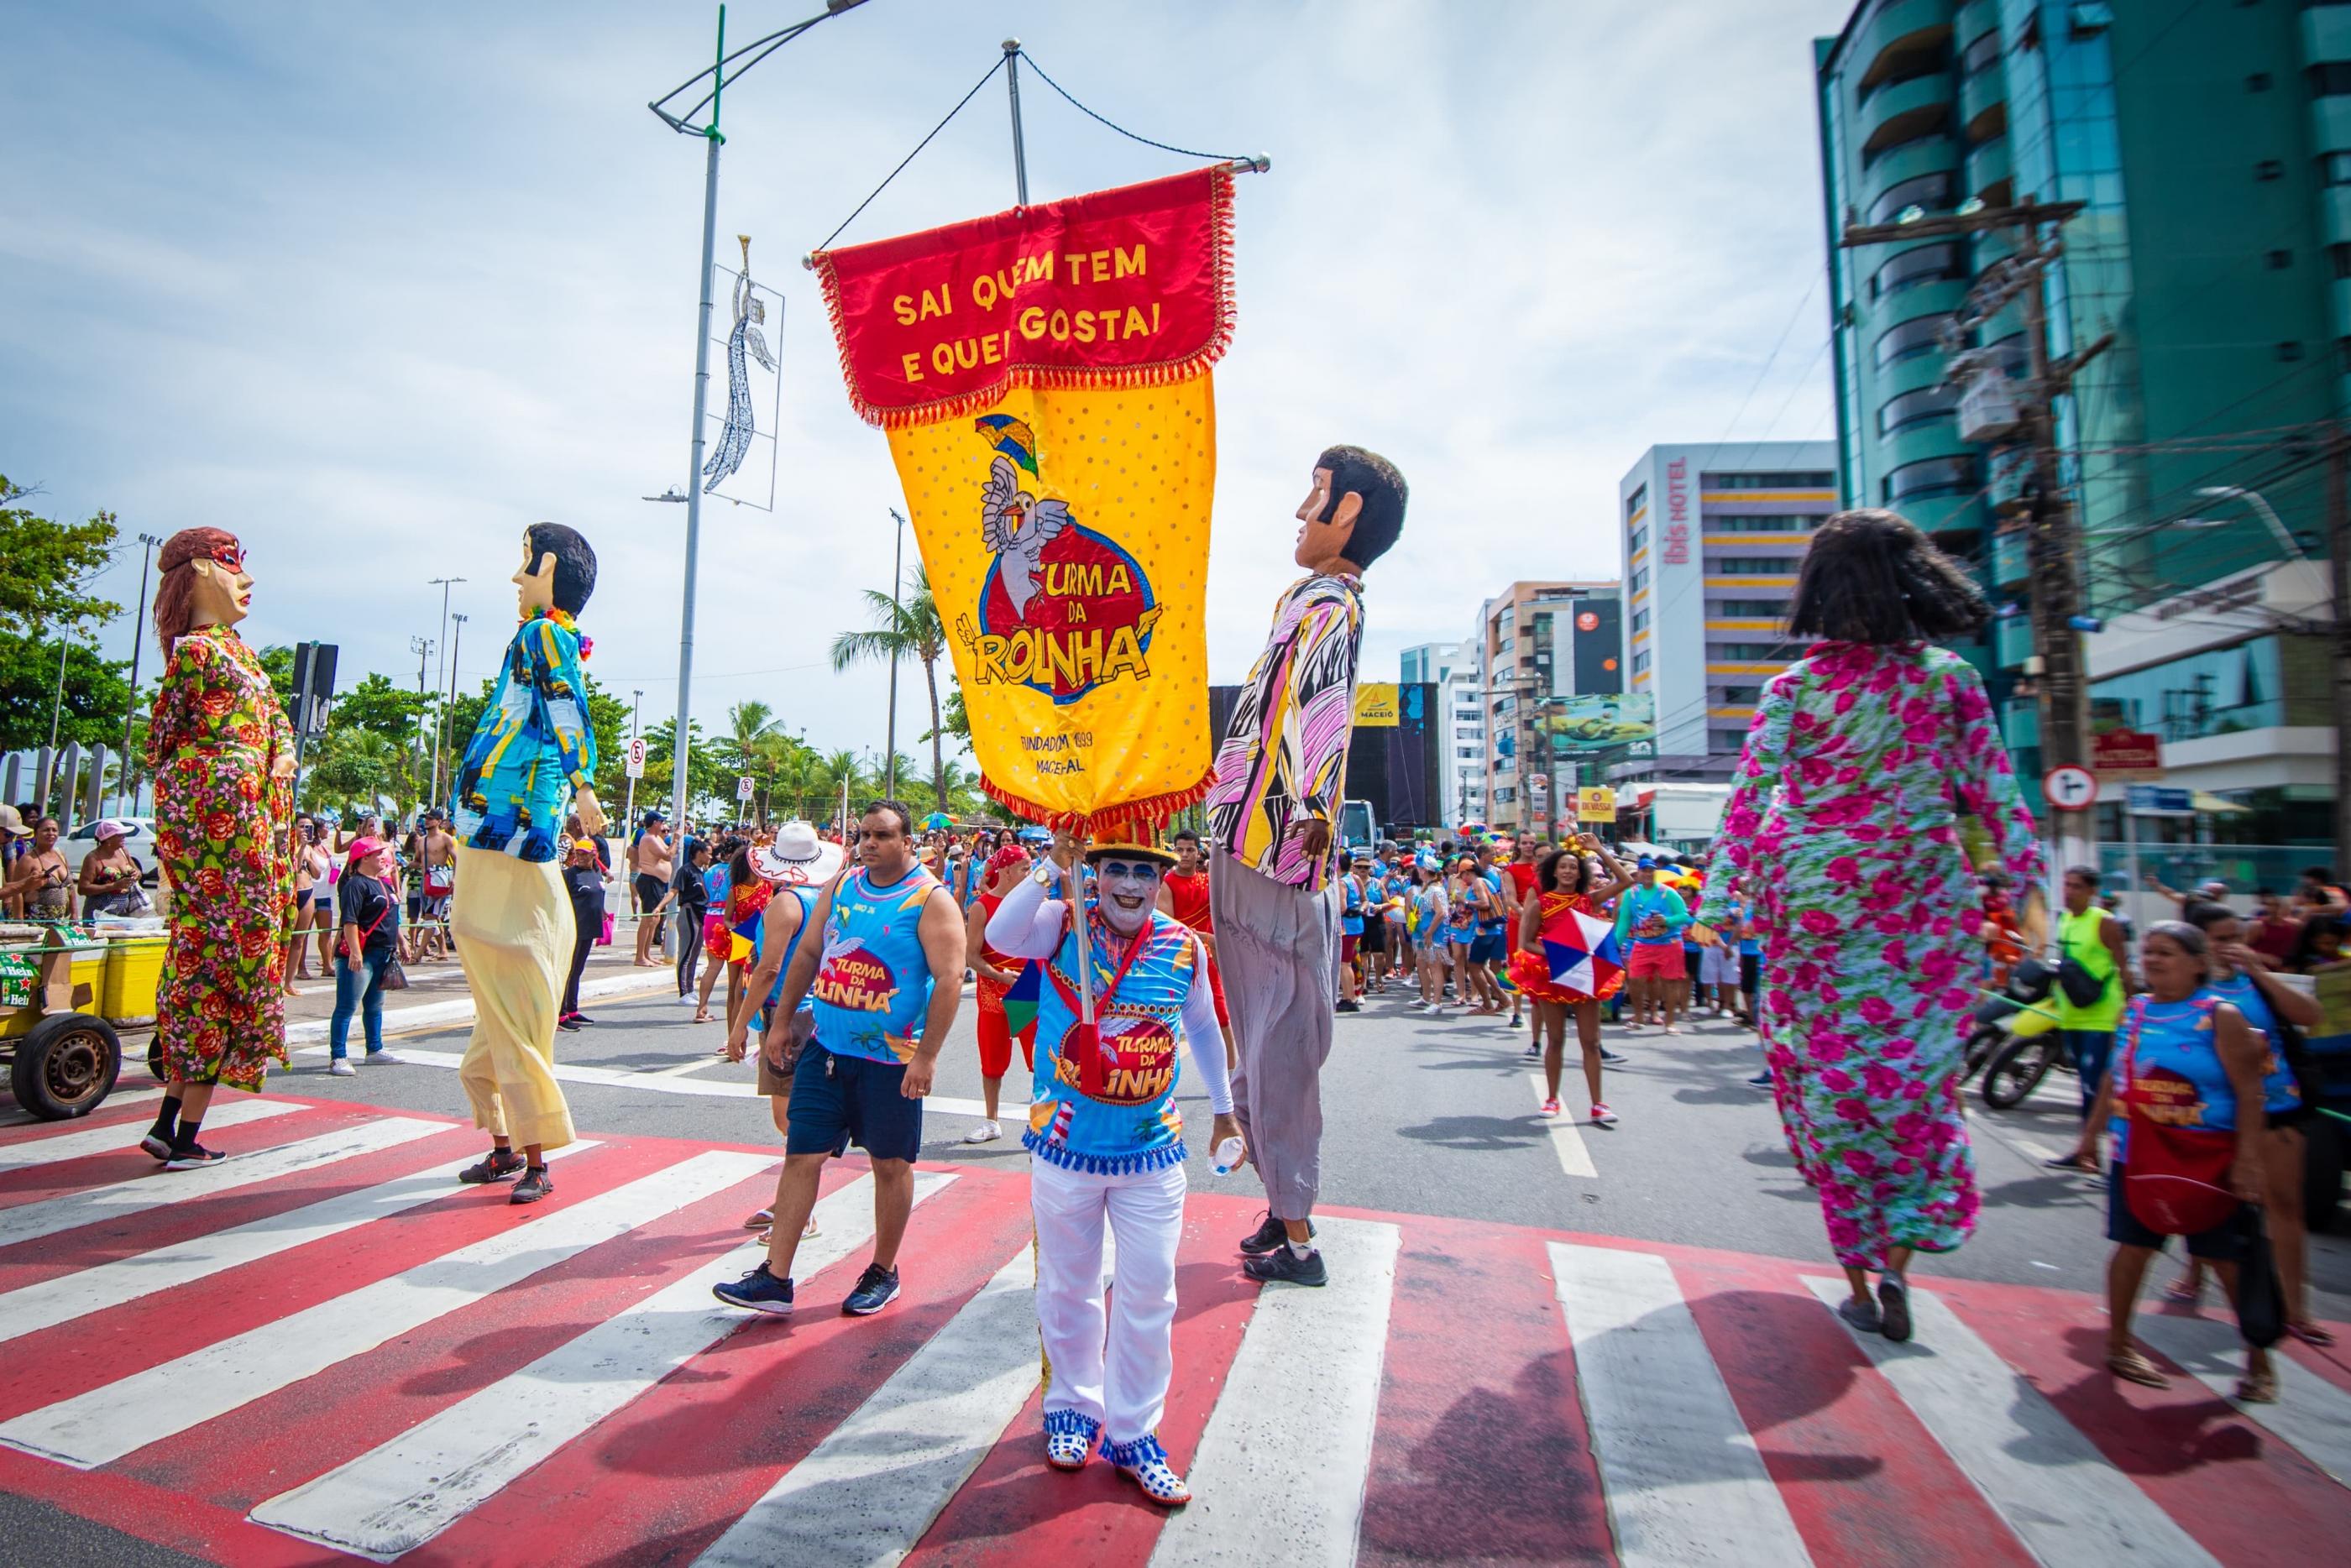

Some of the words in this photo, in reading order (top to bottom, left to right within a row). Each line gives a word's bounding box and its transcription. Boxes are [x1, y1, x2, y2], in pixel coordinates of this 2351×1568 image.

[893, 283, 952, 326] SAI
[972, 250, 1054, 311] QUEM
[1064, 243, 1146, 285] TEM
[902, 353, 924, 383] E
[932, 330, 1010, 375] QUE
[1667, 456, 1687, 521] HOTEL
[1039, 562, 1132, 597] URMA
[1068, 600, 1087, 624] DA
[1582, 802, 1612, 812] DEVASSA
[835, 958, 886, 980] TURMA
[850, 975, 866, 987] DA
[1116, 1036, 1172, 1054] TURMA
[1140, 1054, 1156, 1066] DA
